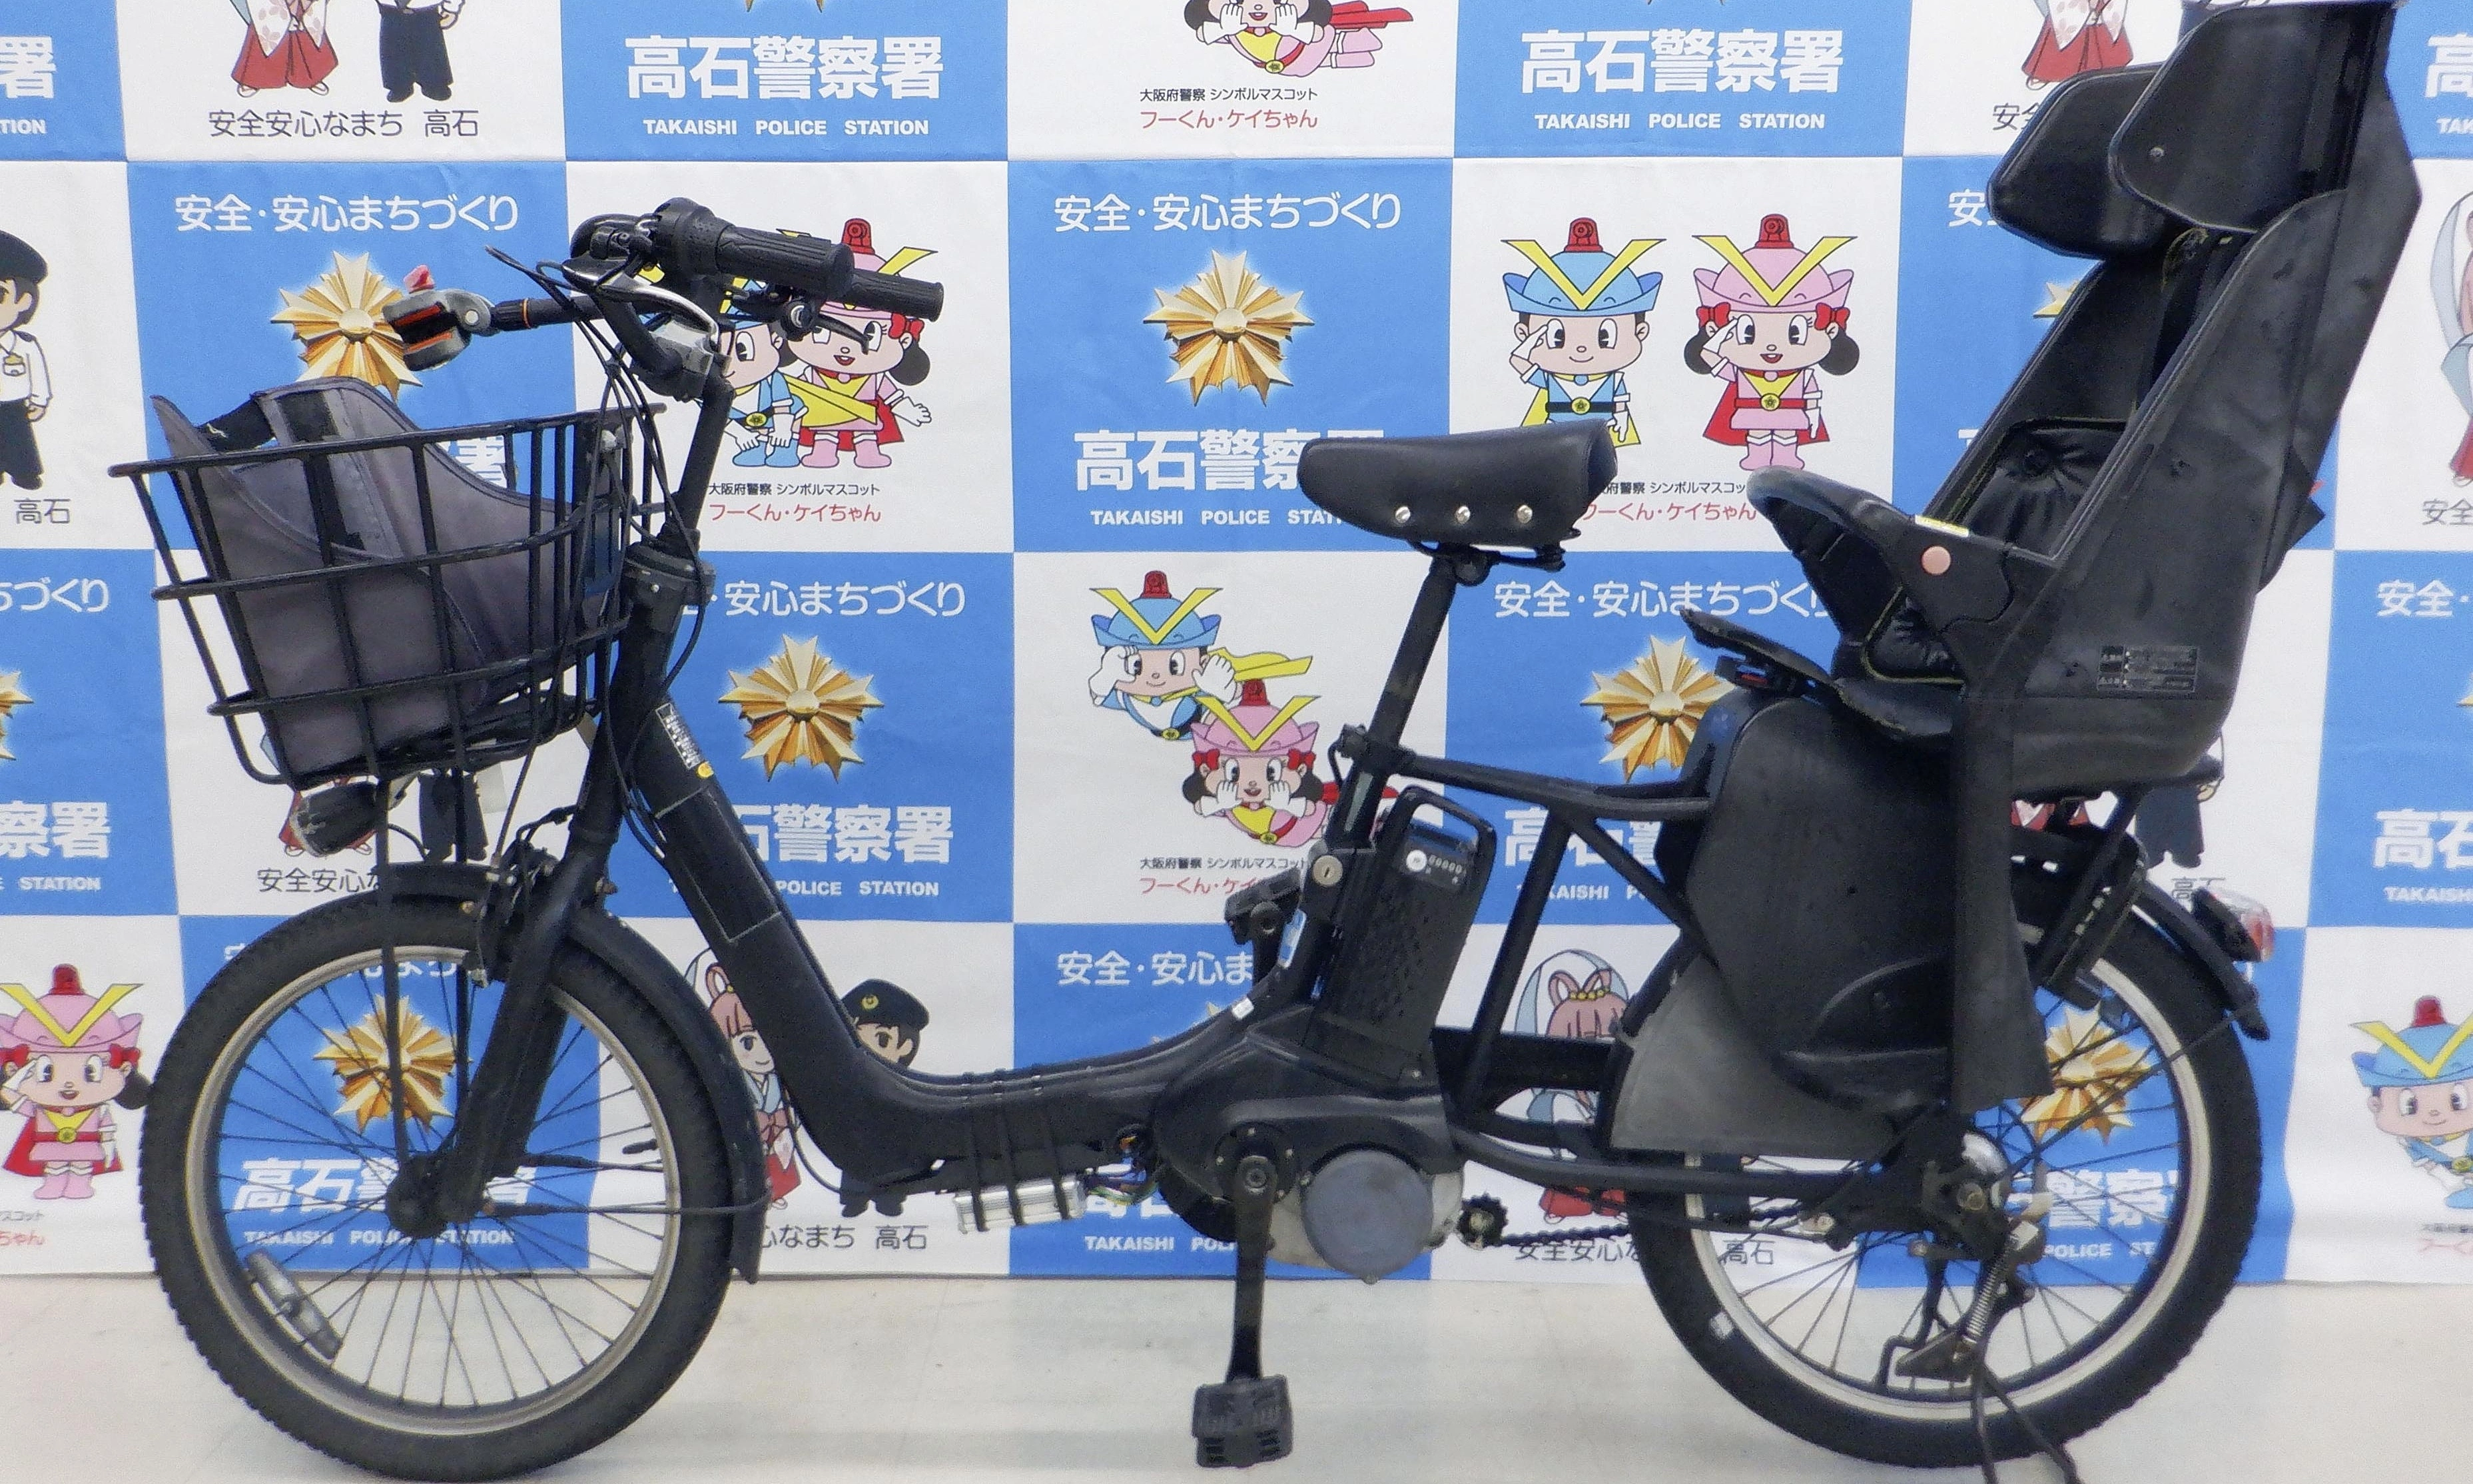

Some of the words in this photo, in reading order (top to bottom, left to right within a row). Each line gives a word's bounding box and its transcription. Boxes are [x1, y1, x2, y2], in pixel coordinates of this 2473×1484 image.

[625, 35, 944, 99] 高石警察署
[1521, 28, 1844, 93] 高石警察署
[1140, 88, 1206, 102] 大阪府警察
[1210, 87, 1318, 101] シンボルマスコット
[208, 109, 403, 138] 安全安心なまち
[424, 109, 479, 138] 高石
[643, 119, 737, 135] TAKAISHI
[755, 119, 827, 136] POLICE
[845, 119, 929, 136] STATION
[1140, 109, 1318, 129] フーくん・ケイちゃん
[1535, 113, 1630, 130] TAKAISHI
[1648, 113, 1722, 130] POLICE
[1739, 113, 1826, 130] STATION
[175, 193, 519, 233] 安全・安心まちづくり
[1054, 192, 1401, 232] 安全・安心まちづくり
[1948, 190, 1997, 227] 安
[1074, 429, 1384, 492] 高石警察
[709, 482, 772, 496] 大阪府警察
[777, 482, 881, 496] シンボルマスコット
[1600, 481, 1645, 495] 府警察
[13, 497, 71, 524] 高石
[709, 503, 881, 522] フーくん・ケイちゃん
[1090, 510, 1183, 525] TAKAISHI
[1202, 510, 1269, 525] POLICE
[682, 580, 966, 617] ・安心まちづくり
[19, 877, 101, 891] STATION
[775, 879, 843, 896] POLICE
[859, 880, 940, 896] STATION
[2171, 877, 2226, 902] 高
[875, 1224, 929, 1250] 高石
[1084, 1235, 1175, 1252] TAKAISHI
[2043, 1242, 2112, 1258] POLICE
